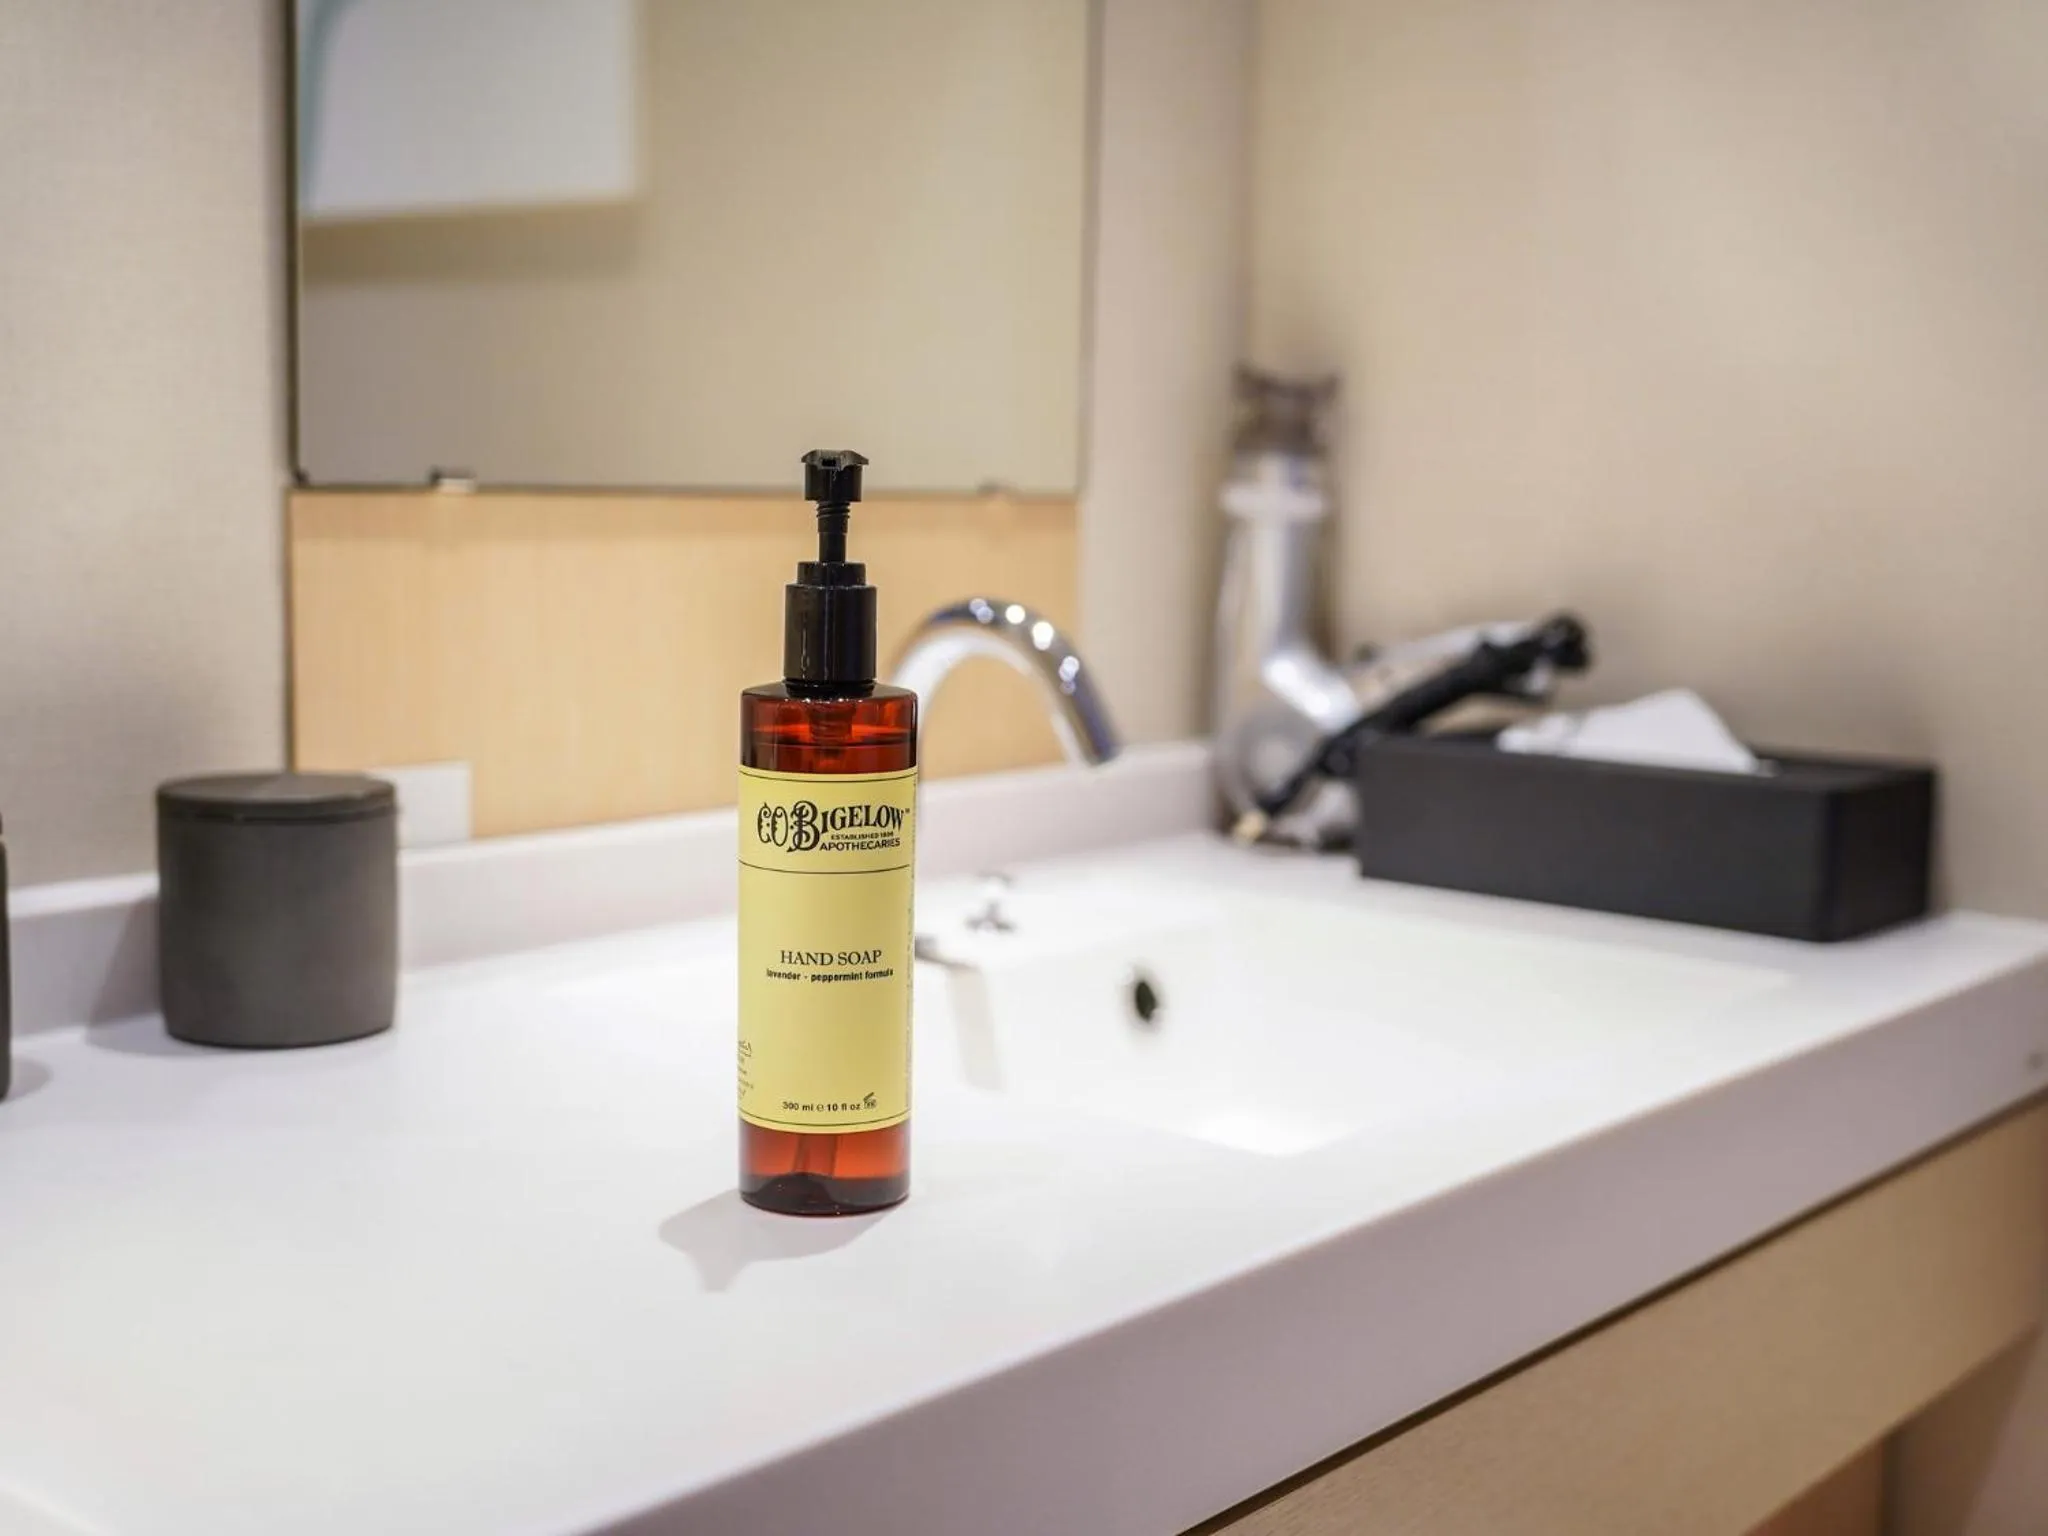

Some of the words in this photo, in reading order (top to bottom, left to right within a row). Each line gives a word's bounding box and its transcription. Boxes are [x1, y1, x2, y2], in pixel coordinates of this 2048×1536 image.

[819, 837, 901, 851] APOTHECARIES
[780, 949, 834, 966] HAND
[838, 949, 882, 966] SOAP
[766, 969, 801, 980] lavender
[811, 971, 863, 983] peppermint
[865, 968, 894, 979] formula
[782, 1101, 800, 1111] 300
[802, 1103, 813, 1112] ml
[827, 1103, 838, 1112] 10
[841, 1103, 848, 1111] fl
[850, 1103, 861, 1111] oz
